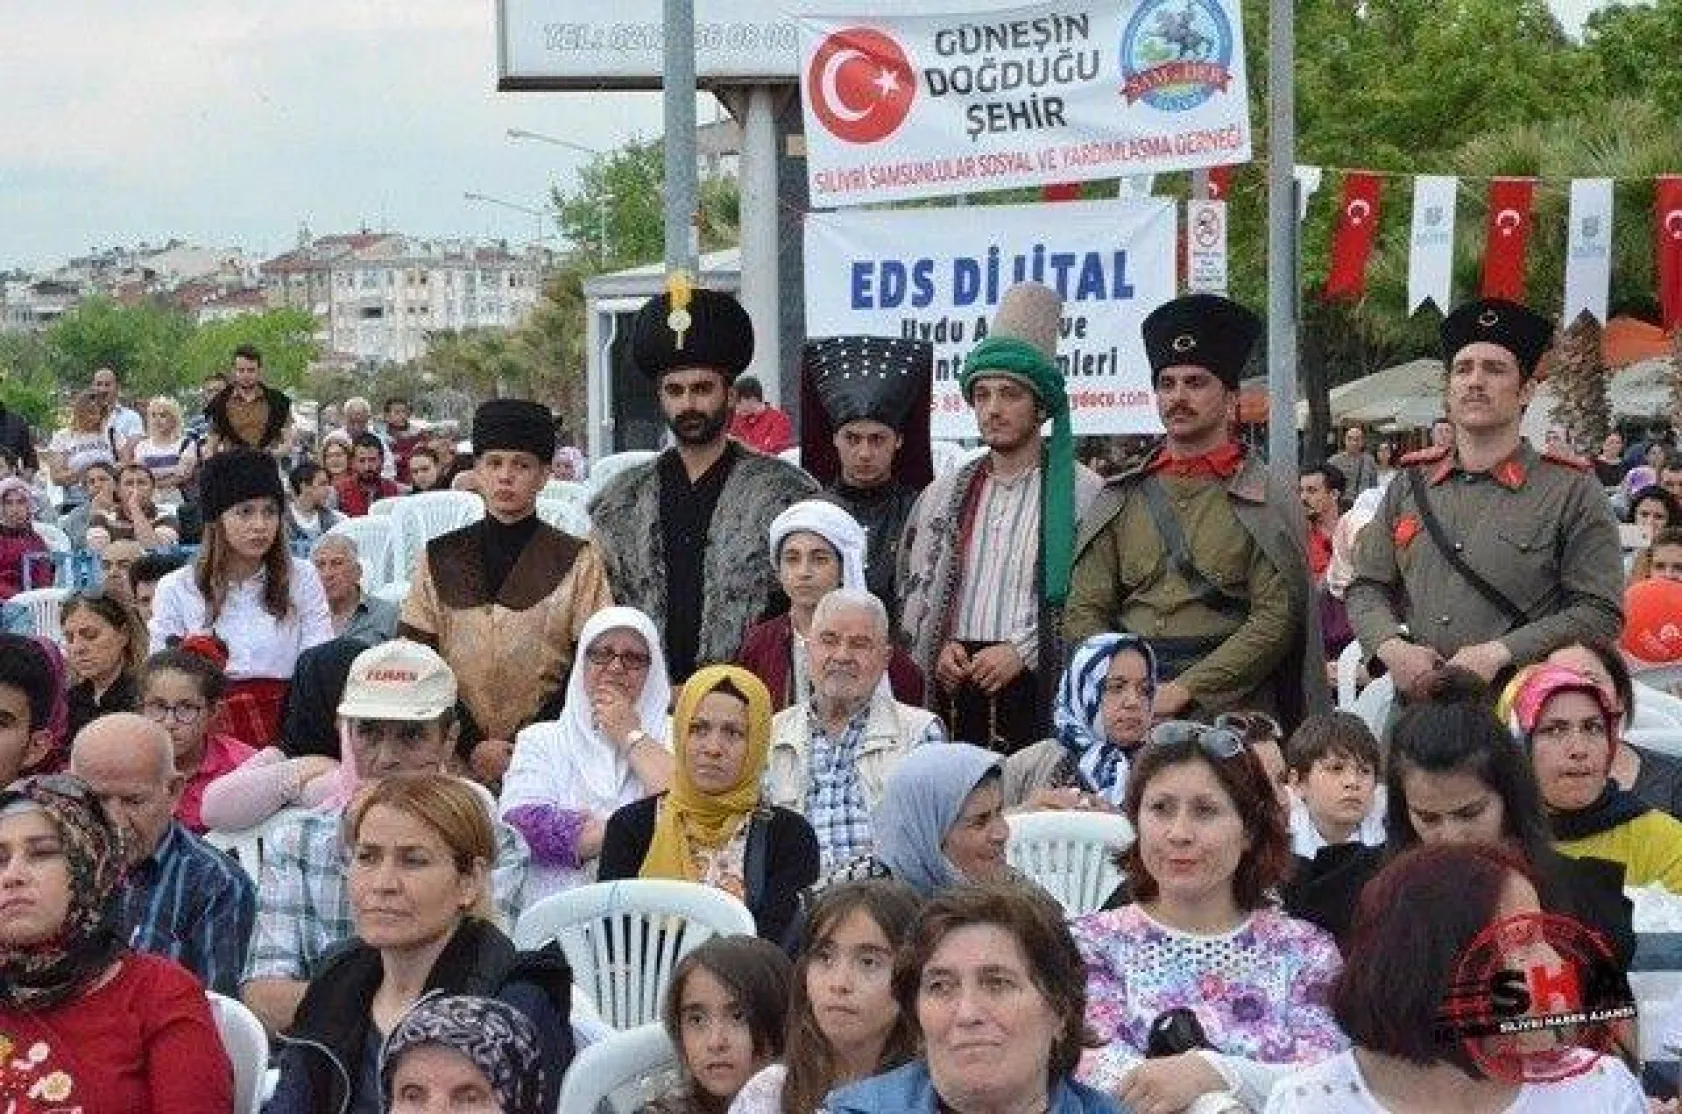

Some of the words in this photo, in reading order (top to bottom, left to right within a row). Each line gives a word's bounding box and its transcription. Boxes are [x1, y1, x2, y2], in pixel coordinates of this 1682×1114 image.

[935, 12, 1089, 56] GÜNEŞİN
[925, 49, 1099, 97] DOĞDUĞU
[967, 93, 1067, 142] ŞEHİR
[979, 151, 1033, 176] SOSYAL
[1038, 147, 1058, 169] VE
[851, 259, 934, 310] EDS
